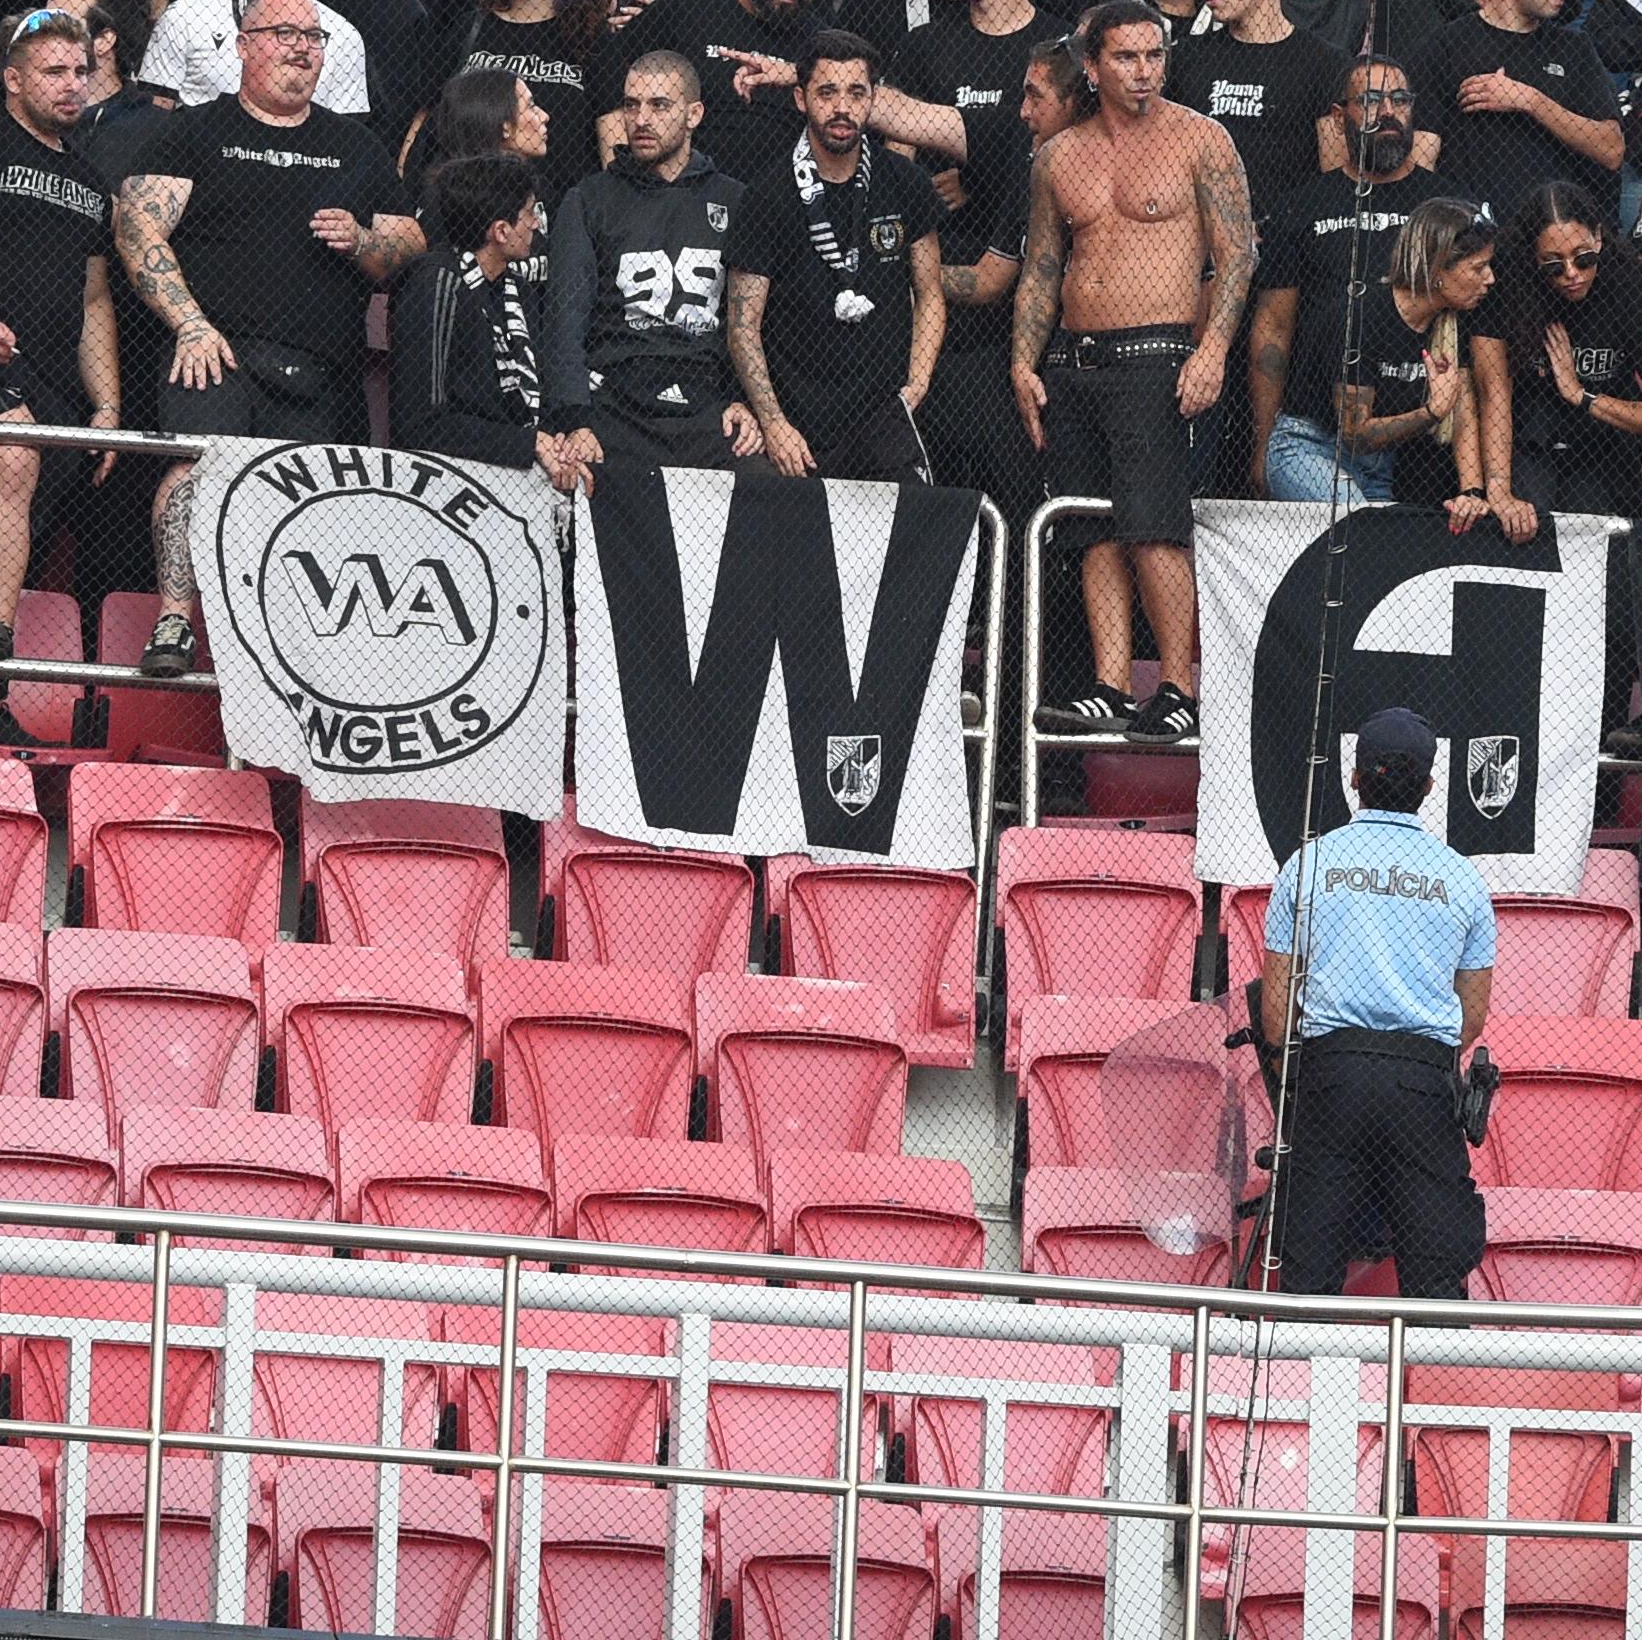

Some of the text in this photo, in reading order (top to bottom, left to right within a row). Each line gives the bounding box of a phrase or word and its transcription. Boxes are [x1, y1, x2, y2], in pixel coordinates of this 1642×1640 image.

[255, 446, 489, 531] WHITE
[588, 461, 983, 858] W
[1324, 864, 1451, 906] POLÍCIA
